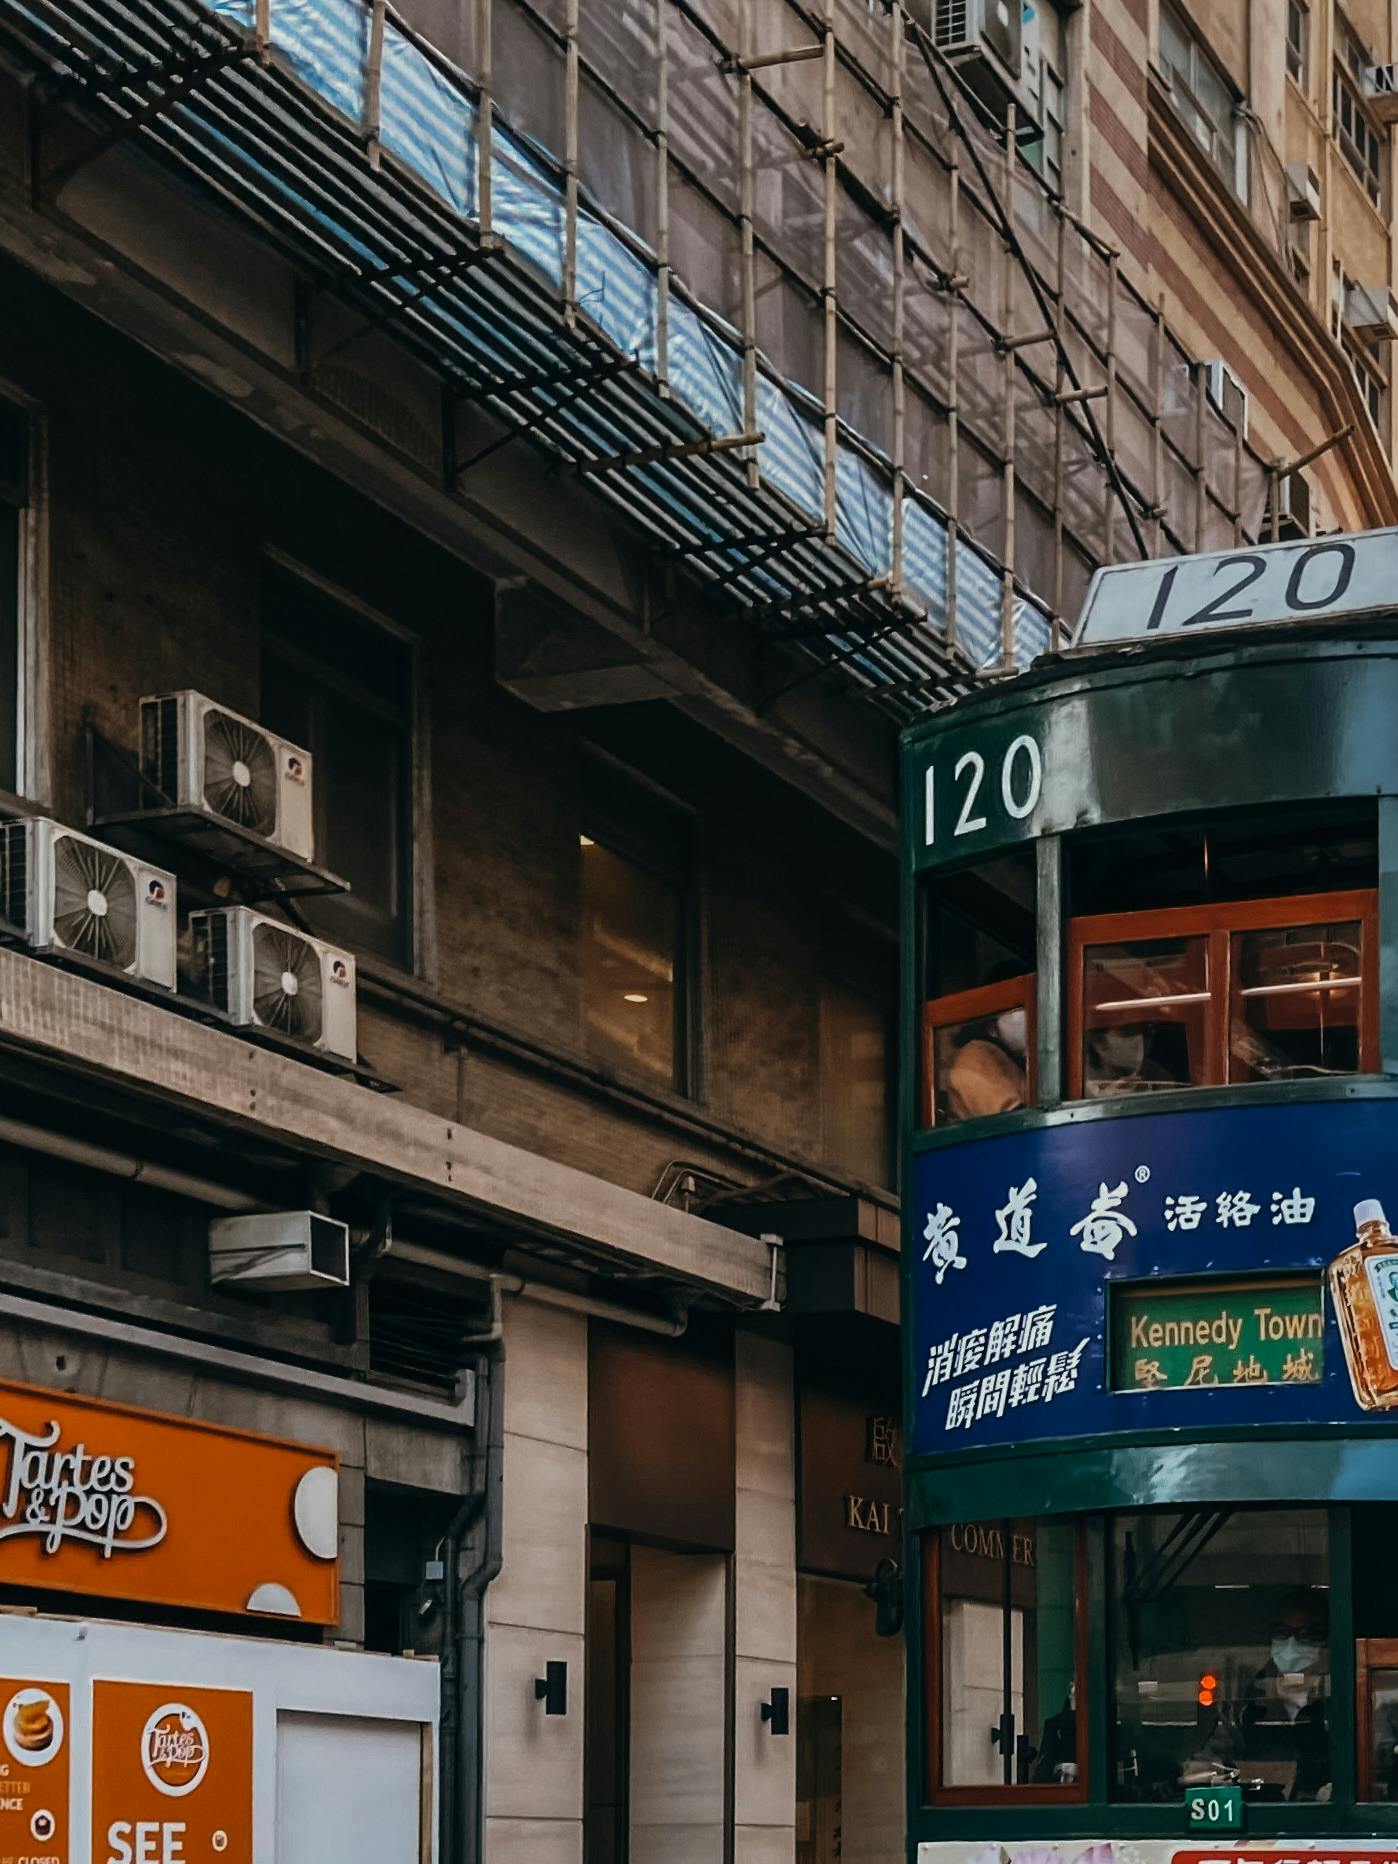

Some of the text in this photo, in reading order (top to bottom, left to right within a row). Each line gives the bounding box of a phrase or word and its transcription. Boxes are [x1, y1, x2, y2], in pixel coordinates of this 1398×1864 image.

[1146, 543, 1355, 629] 120
[925, 734, 1041, 846] 120
[1164, 1187, 1316, 1232] 活絡油
[1131, 1307, 1323, 1351] Kennedy Town
[945, 1337, 1090, 1432] 瞬間輕鬆
[0, 1418, 135, 1518] Tartes
[848, 1495, 890, 1534] KAI
[1191, 1798, 1233, 1822] S01
